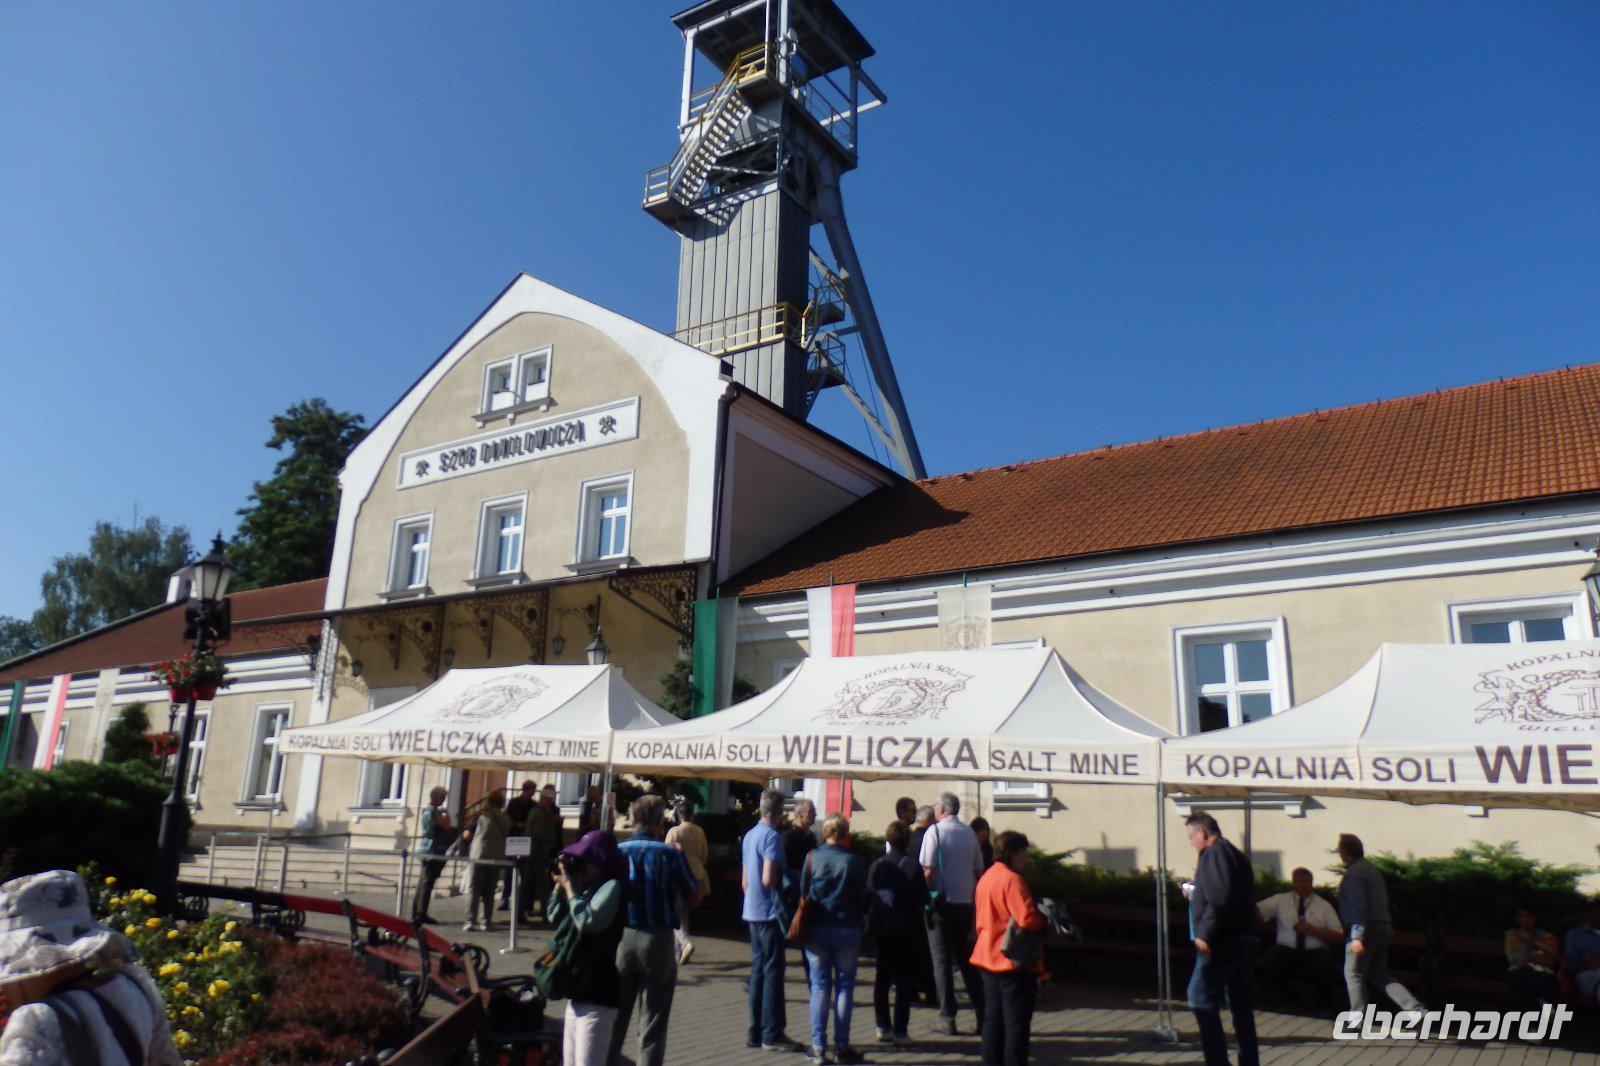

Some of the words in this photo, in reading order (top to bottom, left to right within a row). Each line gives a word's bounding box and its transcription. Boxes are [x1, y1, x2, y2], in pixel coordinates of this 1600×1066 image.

[288, 734, 346, 749] KOPALNIA
[352, 736, 382, 751] SOLI
[387, 730, 507, 755] WIELICZKA
[513, 739, 553, 757] SALT
[559, 741, 600, 757] MINE
[626, 741, 717, 760] KOPALNIA
[726, 744, 770, 762] SOLI
[782, 734, 980, 769] WIELICZKA
[990, 750, 1057, 772] SALT
[1069, 752, 1140, 776] MINE
[1186, 754, 1353, 780] KOPALNIA
[1372, 757, 1456, 783] SOLI
[1474, 744, 1599, 785] WIE
